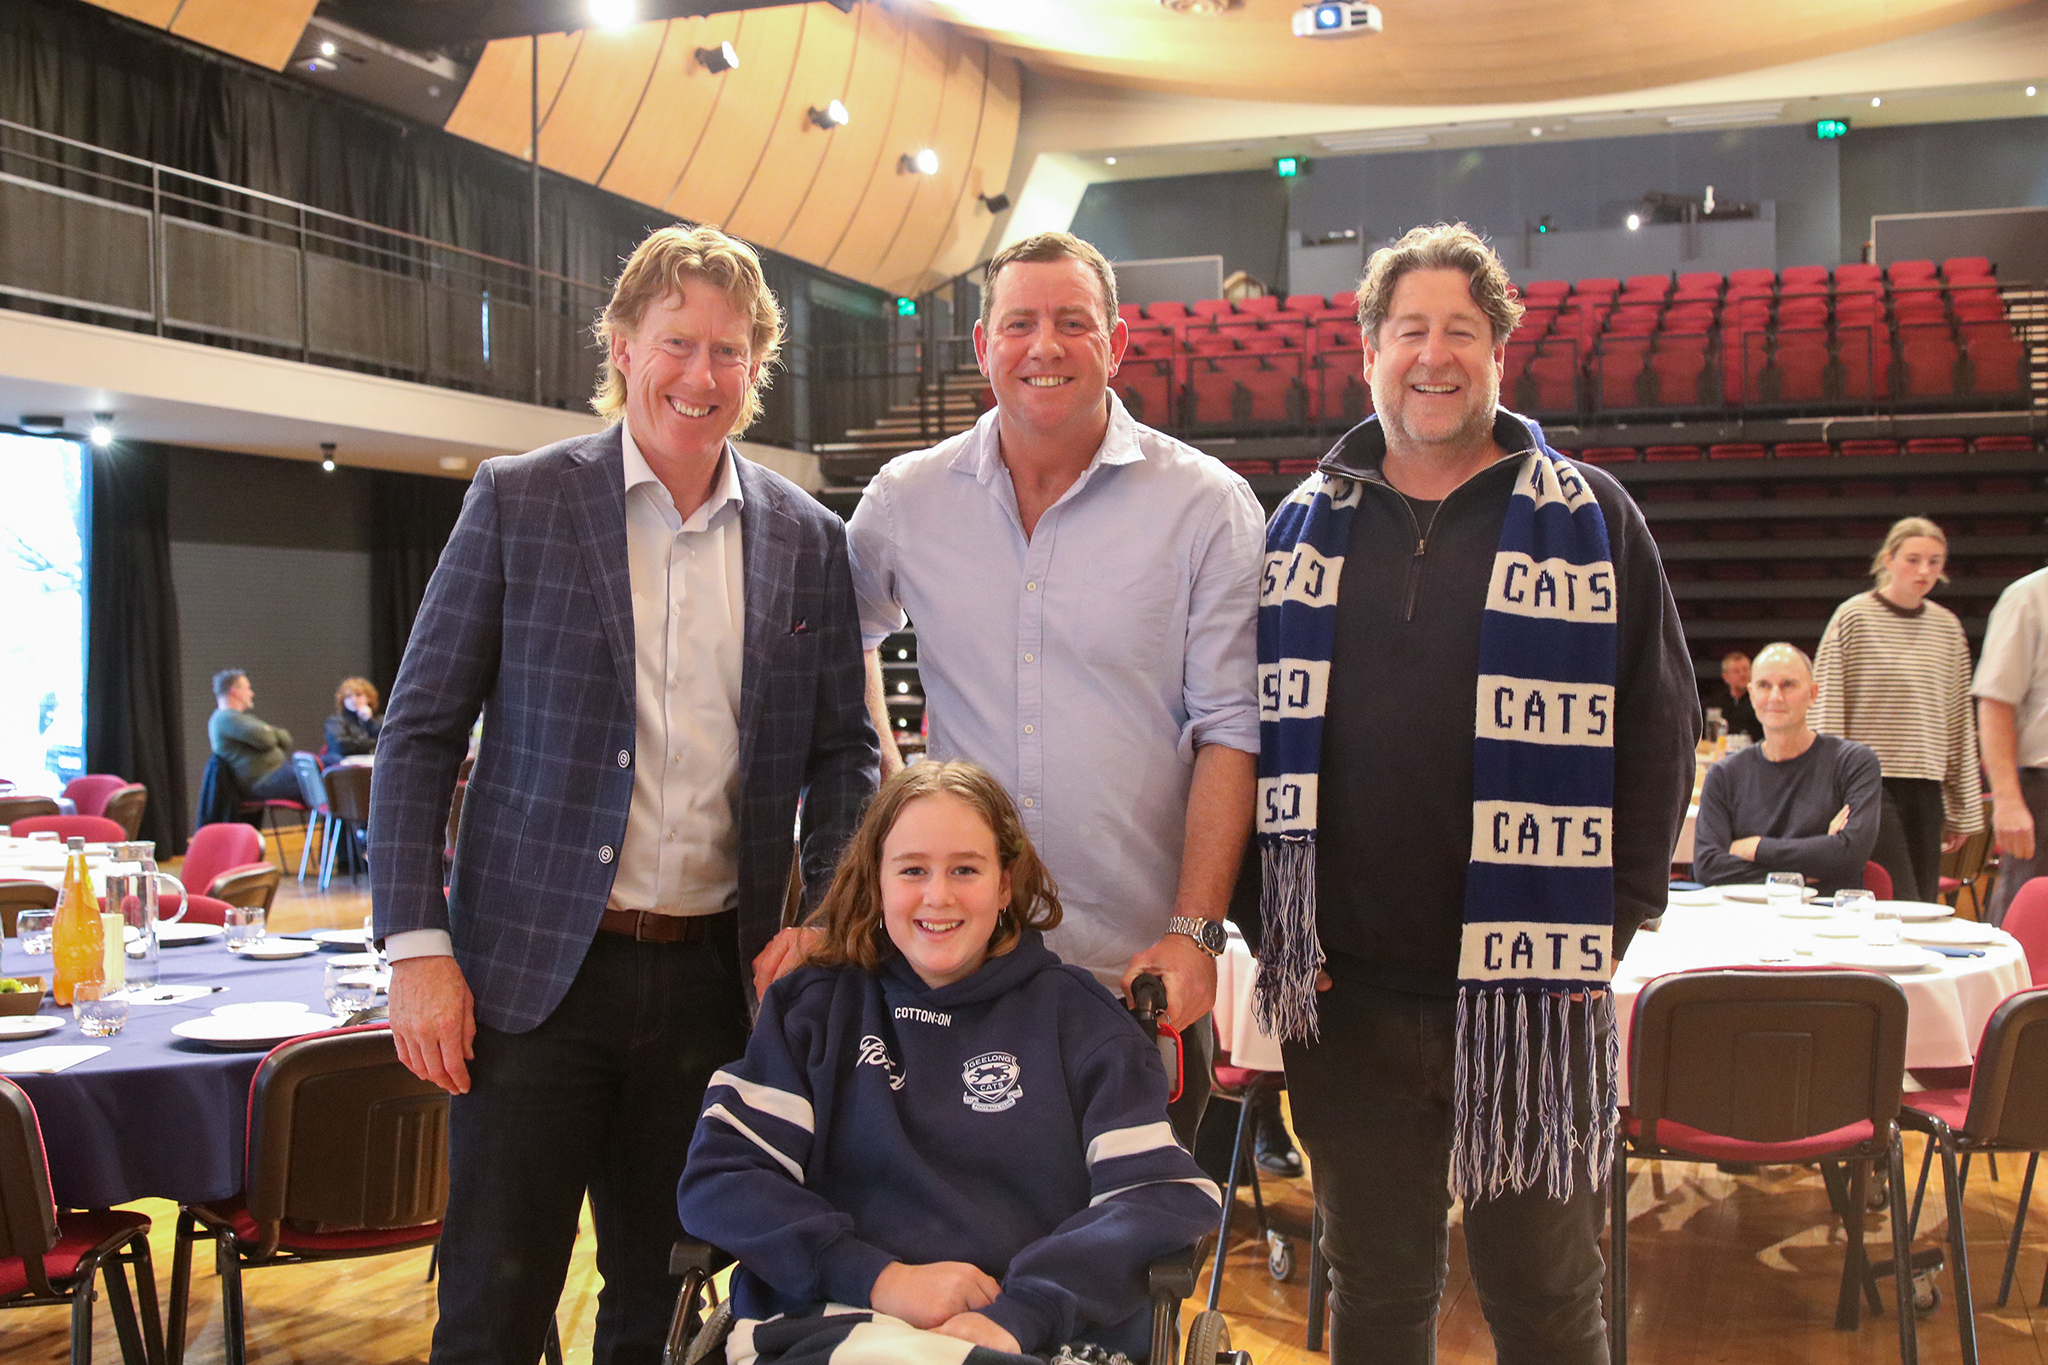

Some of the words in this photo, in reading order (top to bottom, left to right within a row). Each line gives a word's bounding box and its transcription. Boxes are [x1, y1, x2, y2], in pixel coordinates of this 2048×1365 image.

[1503, 561, 1613, 612] CATS
[1494, 686, 1607, 736] CATS
[1492, 811, 1603, 857] CATS
[1484, 931, 1603, 972] CATS
[894, 1006, 952, 1028] COTTON:ON
[968, 1054, 1011, 1069] GEELONG
[980, 1081, 1004, 1092] CATS
